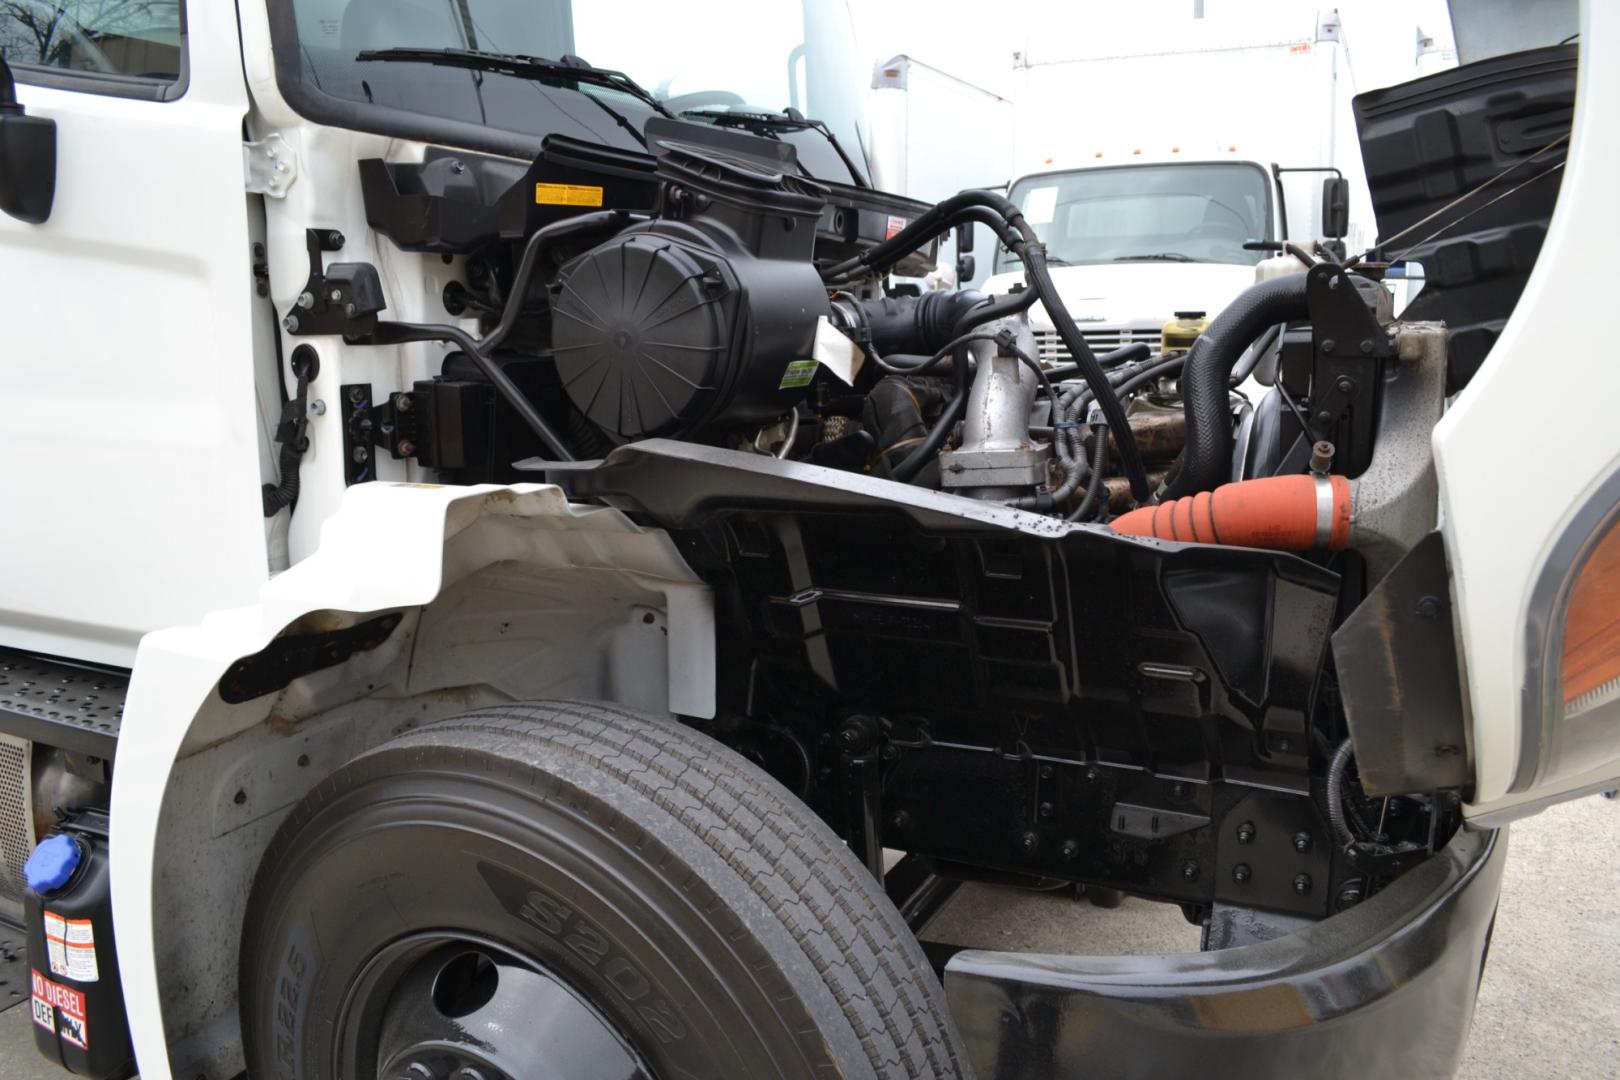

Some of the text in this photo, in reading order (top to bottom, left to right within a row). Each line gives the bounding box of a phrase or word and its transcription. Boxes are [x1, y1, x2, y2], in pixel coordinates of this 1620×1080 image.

[519, 890, 688, 1044] S202
[34, 999, 52, 1025] DEF
[45, 980, 83, 1016] DIESEL
